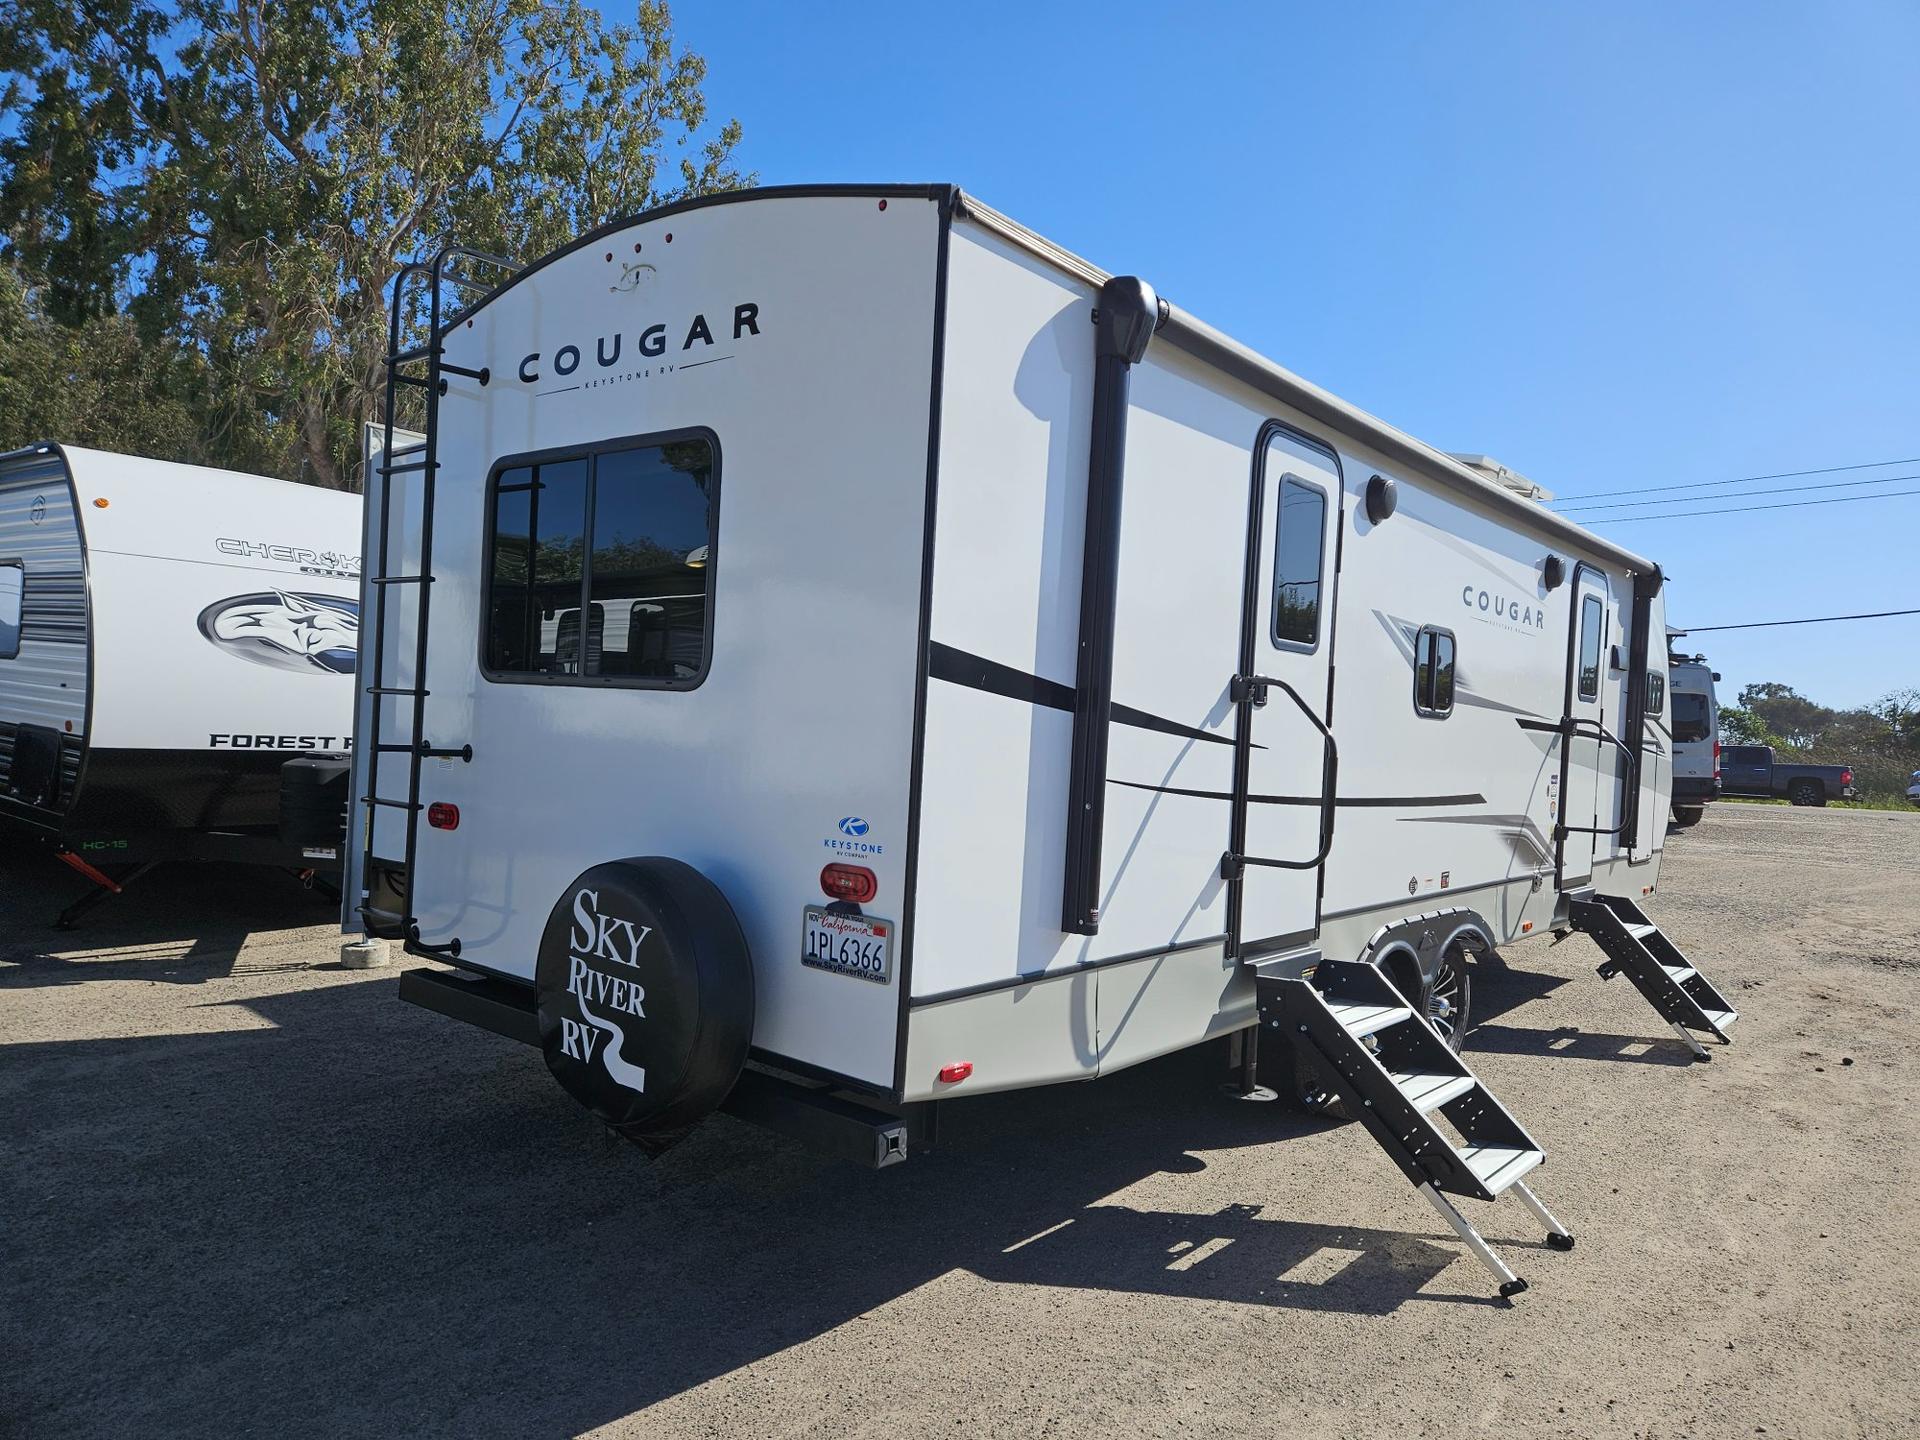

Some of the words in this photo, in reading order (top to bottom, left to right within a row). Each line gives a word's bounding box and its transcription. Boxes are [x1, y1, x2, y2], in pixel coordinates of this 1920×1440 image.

[518, 302, 761, 384] COUGAR
[584, 369, 650, 390] KEYSTONE
[659, 364, 675, 375] RV
[1462, 585, 1544, 630] COUGAR
[209, 733, 337, 749] FOREST
[823, 839, 883, 855] KEYSTONE
[844, 851, 869, 860] COMPANY
[821, 913, 873, 937] California
[808, 929, 883, 972] 1PL6366
[802, 958, 887, 983] www.SkyRiverRV.com
[560, 1016, 599, 1064] RV
